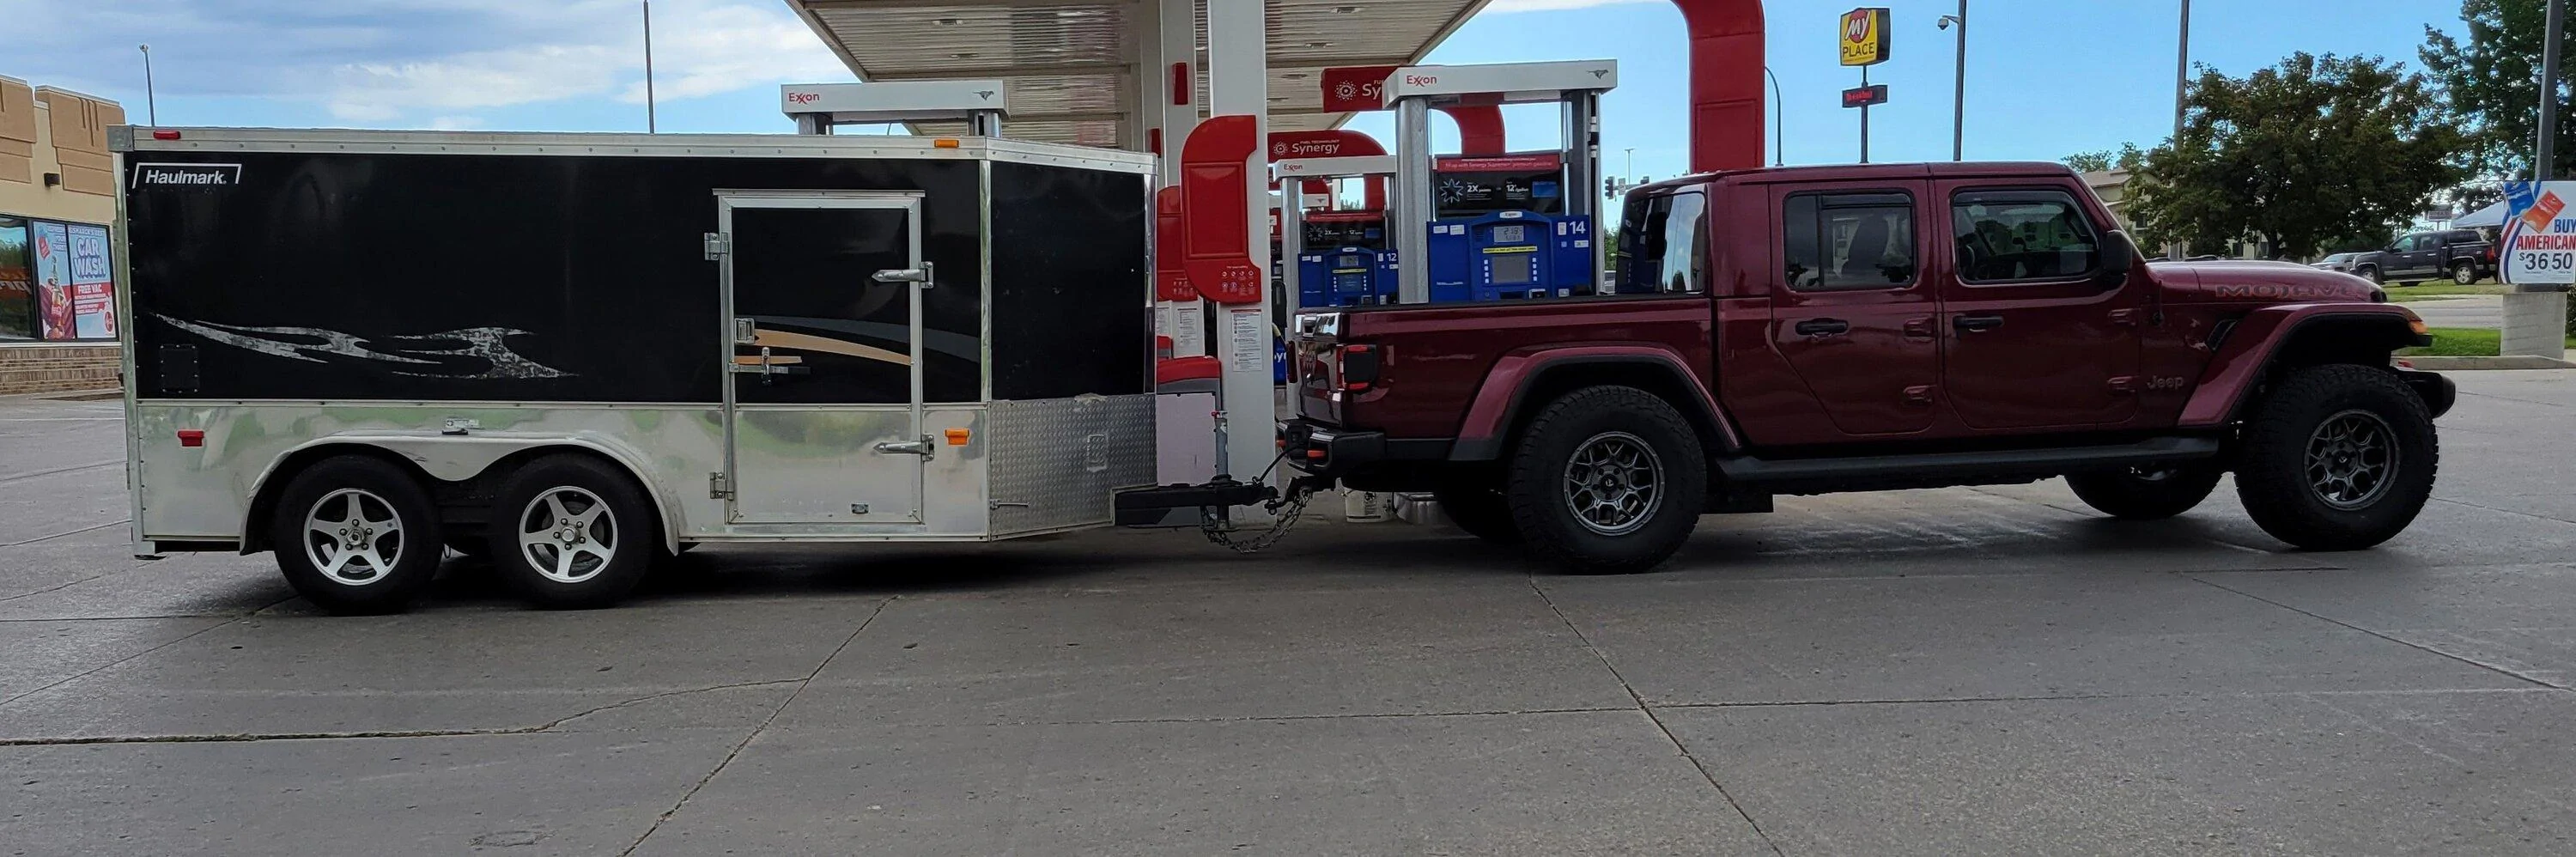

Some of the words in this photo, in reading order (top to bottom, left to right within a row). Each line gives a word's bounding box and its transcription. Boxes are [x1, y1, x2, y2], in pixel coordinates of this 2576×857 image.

[1845, 10, 1870, 40] MY
[1843, 42, 1875, 58] PLACE
[1406, 75, 1437, 88] Exxon
[789, 93, 819, 104] Exxon
[1291, 143, 1340, 155] Synergy
[1284, 163, 1303, 172] Exxon
[145, 169, 224, 185] Haulmark
[1569, 221, 1586, 234] 14
[2554, 219, 2576, 234] BUY
[77, 238, 100, 257] CAR
[2516, 235, 2576, 250] AMERICAN
[1386, 252, 1397, 262] 12
[74, 256, 106, 277] WASH
[2147, 374, 2184, 390] Jeep
